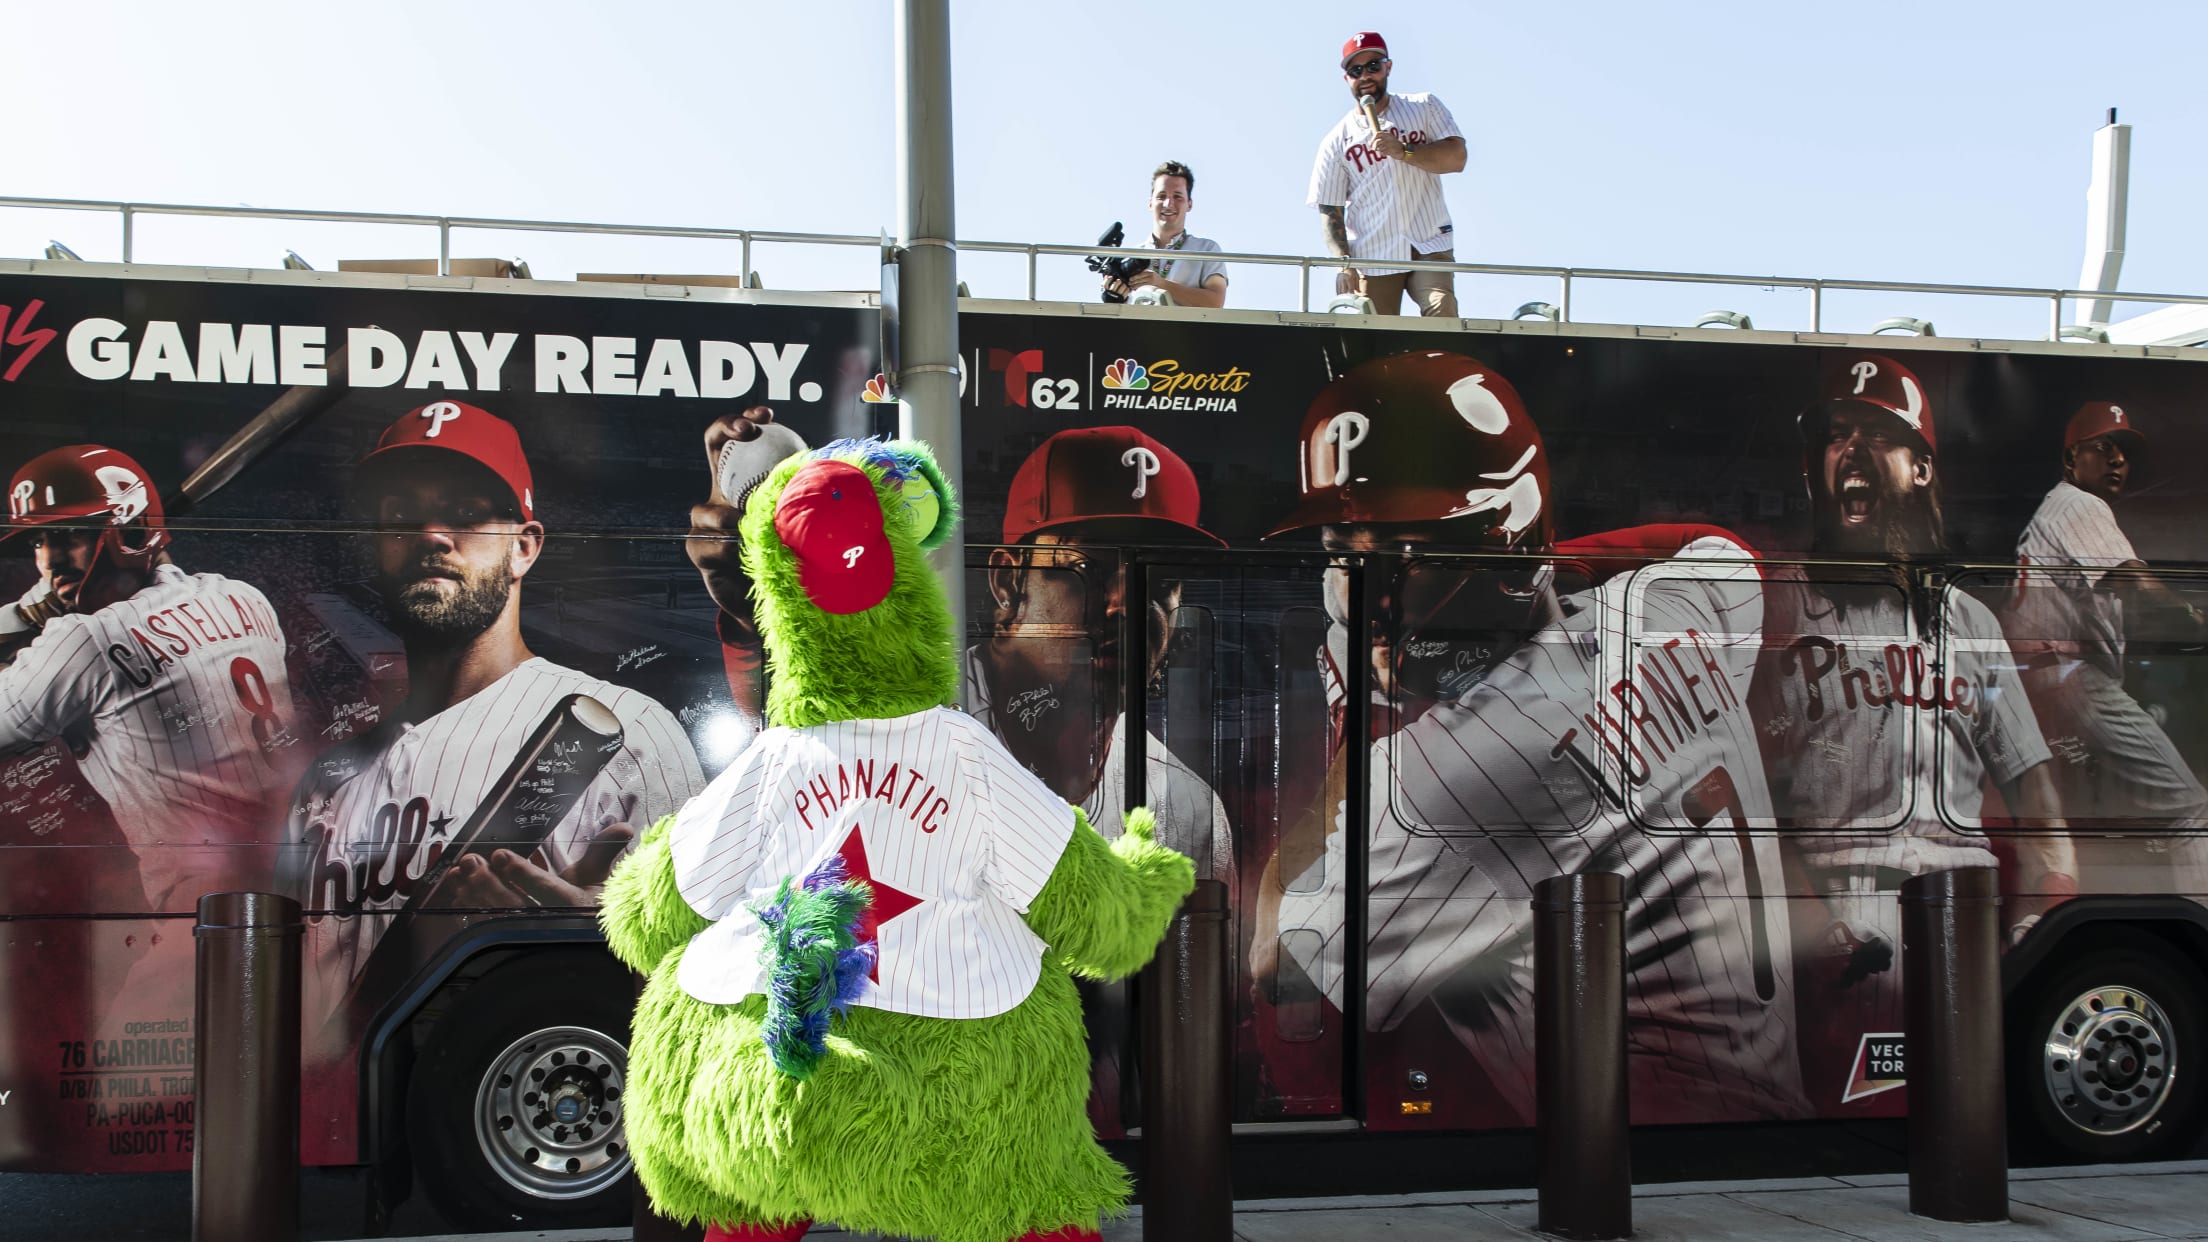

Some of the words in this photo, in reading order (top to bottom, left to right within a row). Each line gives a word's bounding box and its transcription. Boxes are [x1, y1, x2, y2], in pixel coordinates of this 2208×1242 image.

[1353, 33, 1366, 48] P
[66, 317, 328, 386] GAME
[347, 327, 519, 391] DAY
[534, 334, 823, 403] READY.
[1147, 359, 1250, 397] Sports
[1850, 361, 1878, 395] P
[1031, 377, 1080, 411] 62
[1103, 394, 1238, 413] PHILADELPHIA
[421, 401, 461, 438] P
[2109, 405, 2124, 424] P
[1325, 411, 1370, 487] P
[1121, 446, 1161, 499] P
[842, 545, 864, 568] P
[230, 656, 287, 772] 8
[794, 758, 949, 834] PHANATIC
[124, 1017, 189, 1037] operated
[58, 1040, 87, 1069] 76
[1871, 1044, 1905, 1057] VEC
[1870, 1060, 1905, 1073] TOR
[60, 1077, 104, 1100] D/B/A
[108, 1076, 158, 1099] PHILA.
[109, 1130, 169, 1156] USDOT
